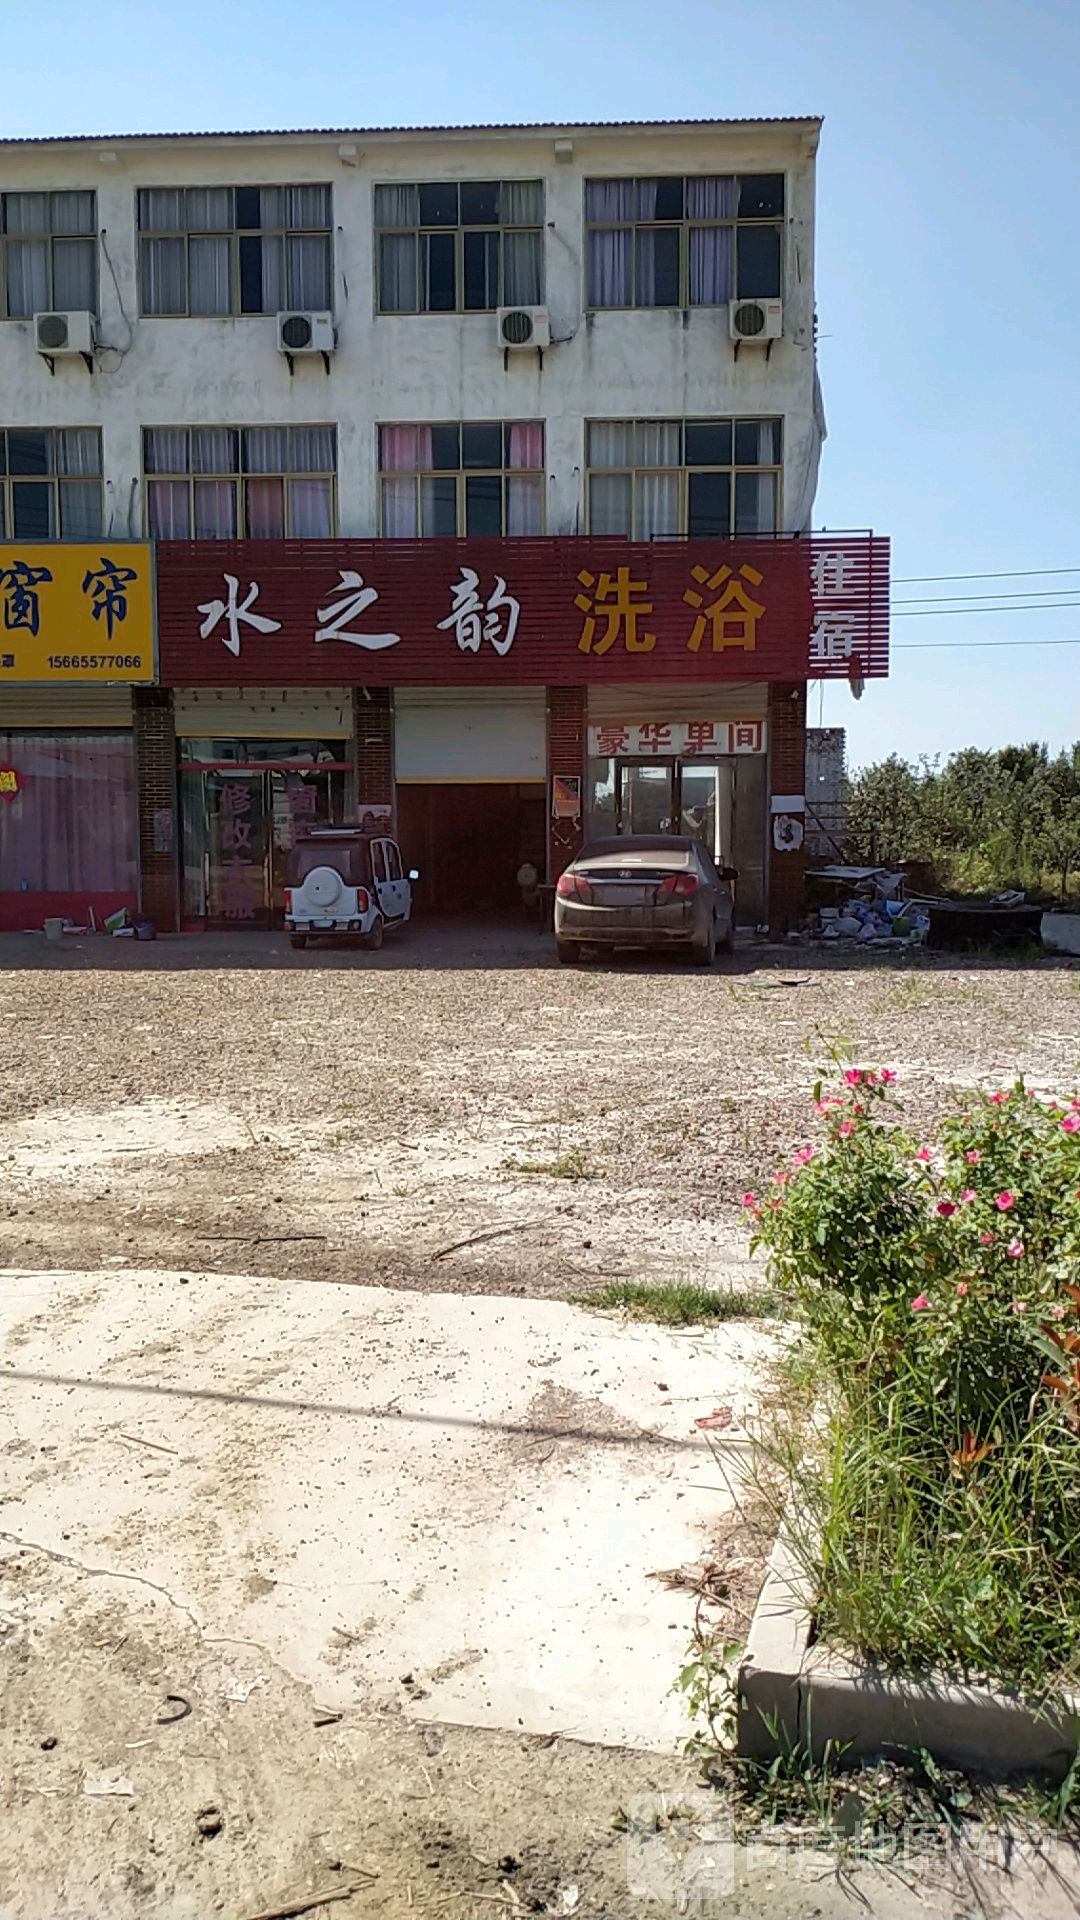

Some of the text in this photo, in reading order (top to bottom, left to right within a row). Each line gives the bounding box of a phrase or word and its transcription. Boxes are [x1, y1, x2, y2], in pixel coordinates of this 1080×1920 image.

[0, 557, 137, 641] 窗帘
[196, 564, 766, 656] 水之韵 洗浴
[47, 655, 141, 669] 15665577066
[596, 721, 762, 755] 豪华单间
